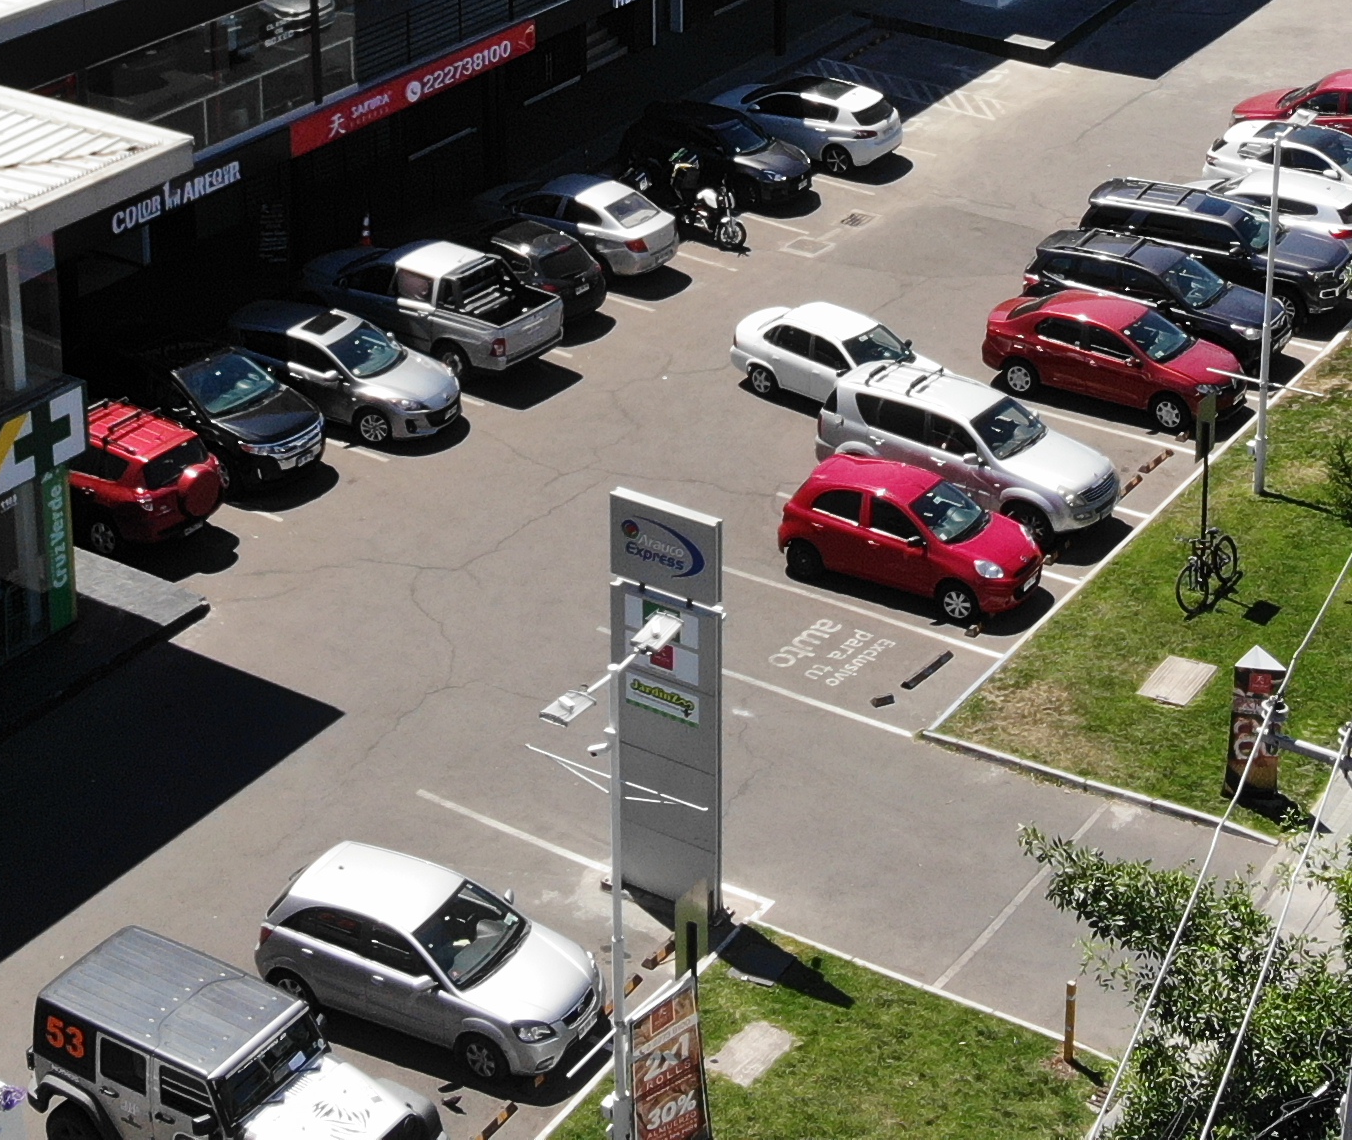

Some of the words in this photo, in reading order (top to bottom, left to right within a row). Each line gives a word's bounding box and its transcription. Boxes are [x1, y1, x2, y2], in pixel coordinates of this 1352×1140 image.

[423, 40, 511, 94] 222738100
[111, 194, 161, 235] COLOR
[48, 483, 66, 547] Verde
[625, 541, 685, 571] Express
[637, 534, 684, 557] Arauco
[768, 618, 843, 668] auto
[825, 638, 896, 687] Exclusivo
[826, 628, 874, 660] para
[804, 664, 834, 680] tu
[46, 1015, 85, 1059] 53
[644, 1032, 690, 1081] 2x1
[646, 1059, 691, 1091] ROLLS
[646, 1089, 697, 1131] 30%
[647, 1110, 697, 1140] ALMUERZO
